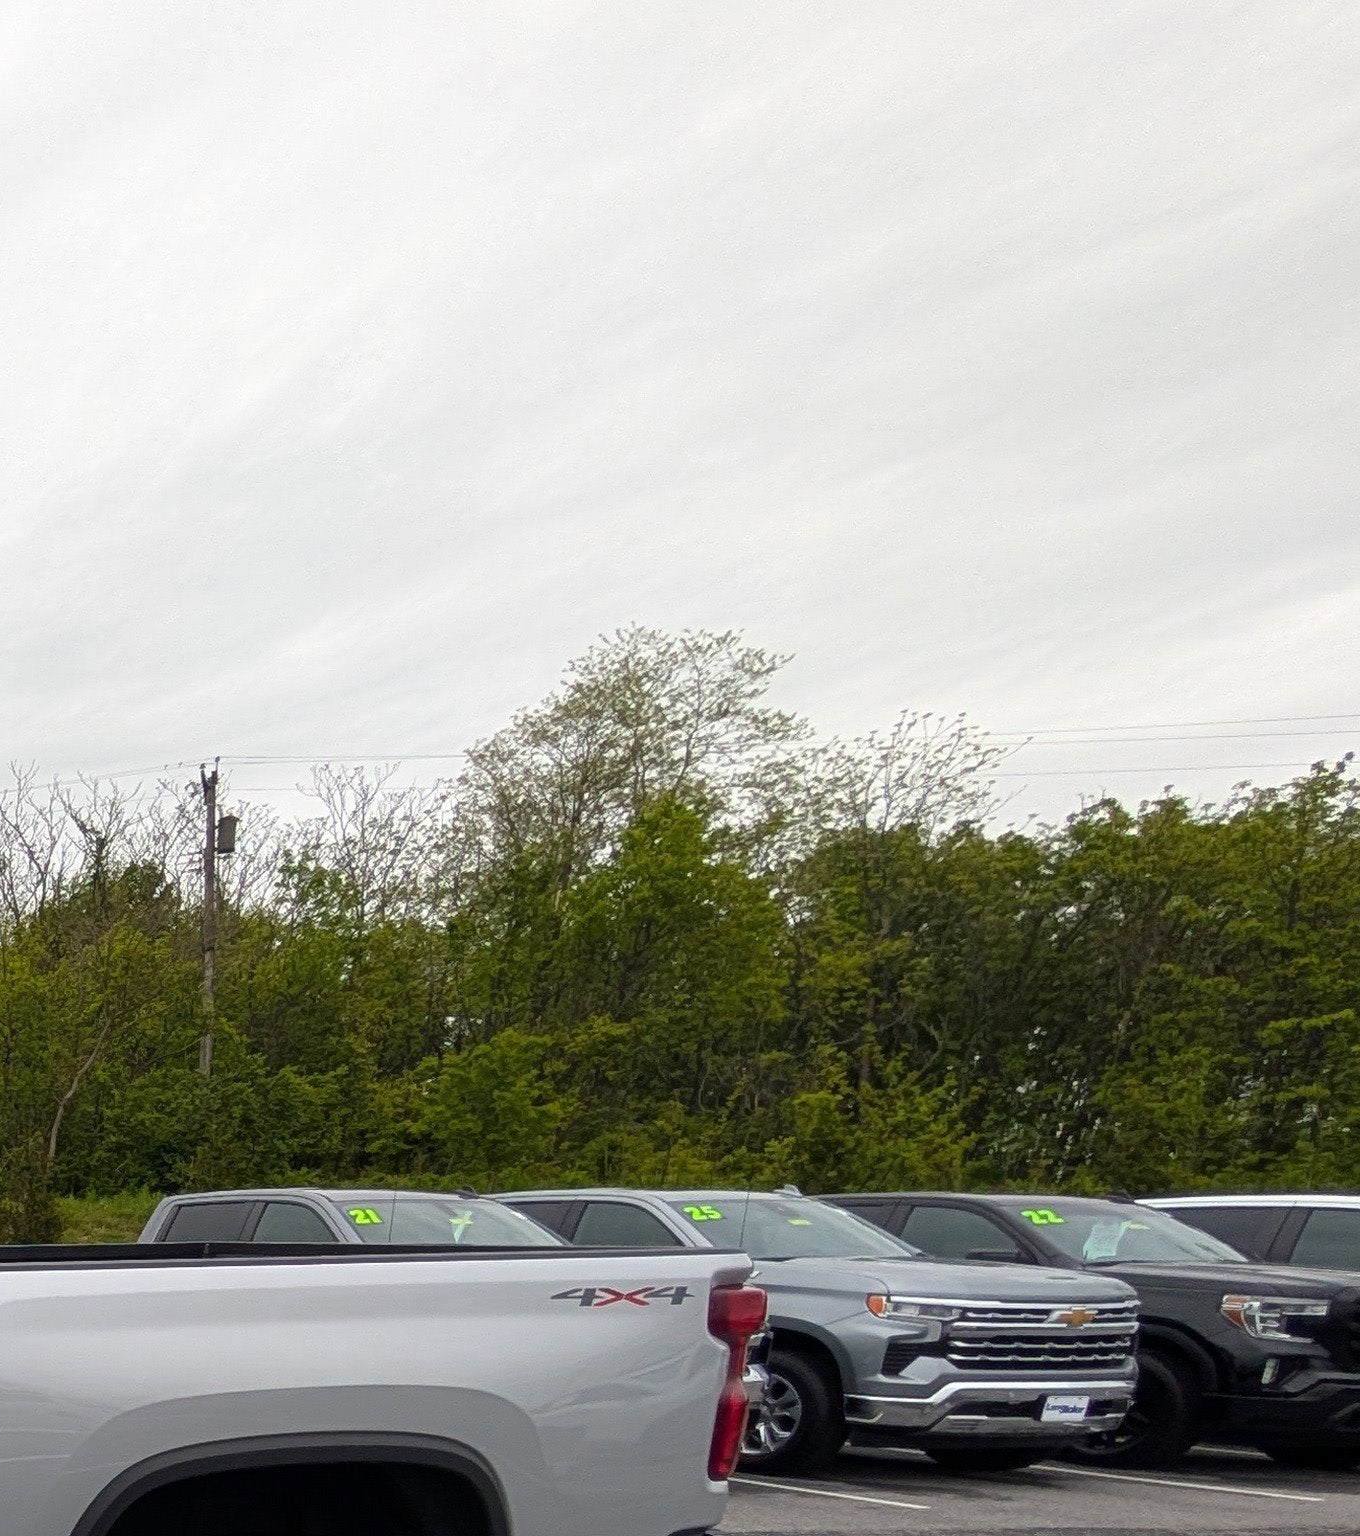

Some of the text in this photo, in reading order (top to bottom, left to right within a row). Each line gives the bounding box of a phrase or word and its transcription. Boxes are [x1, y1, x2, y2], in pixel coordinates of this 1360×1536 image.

[347, 1207, 383, 1226] 21
[682, 1204, 723, 1222] 25
[1020, 1208, 1065, 1226] 22
